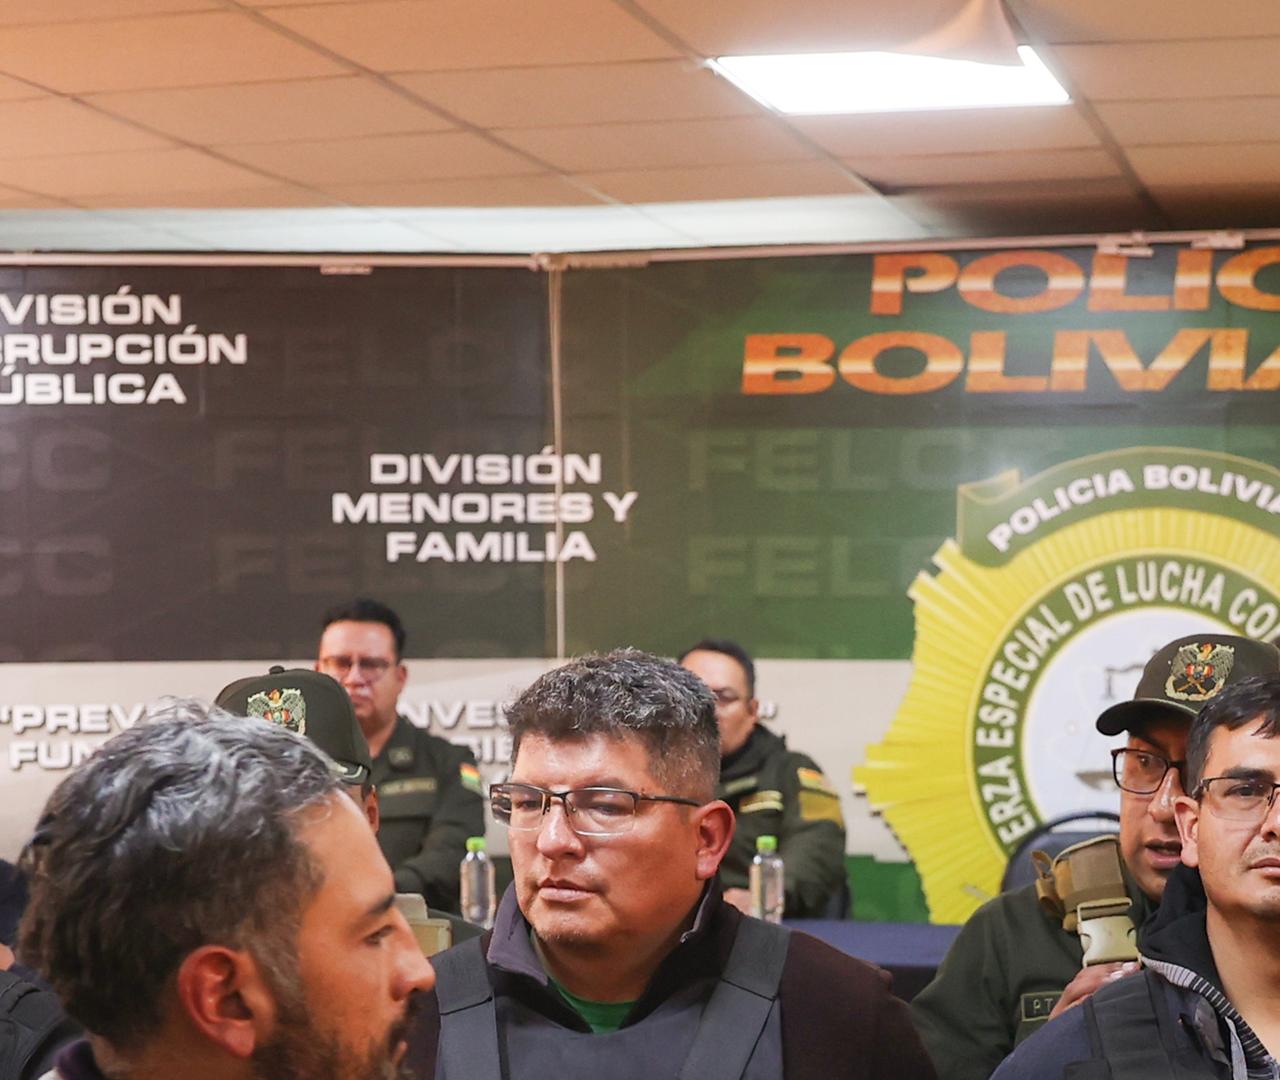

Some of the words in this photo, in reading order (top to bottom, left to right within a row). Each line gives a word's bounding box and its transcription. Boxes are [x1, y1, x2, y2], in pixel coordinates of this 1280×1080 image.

[370, 445, 601, 484] DIVISIÓN
[332, 492, 594, 523] MENORES
[603, 491, 638, 522] Y
[986, 468, 1135, 552] POLICIA
[386, 531, 597, 562] FAMILIA
[975, 603, 1074, 748] ESPECIAL
[1063, 570, 1115, 622] DE
[1116, 560, 1226, 616] LUCHA
